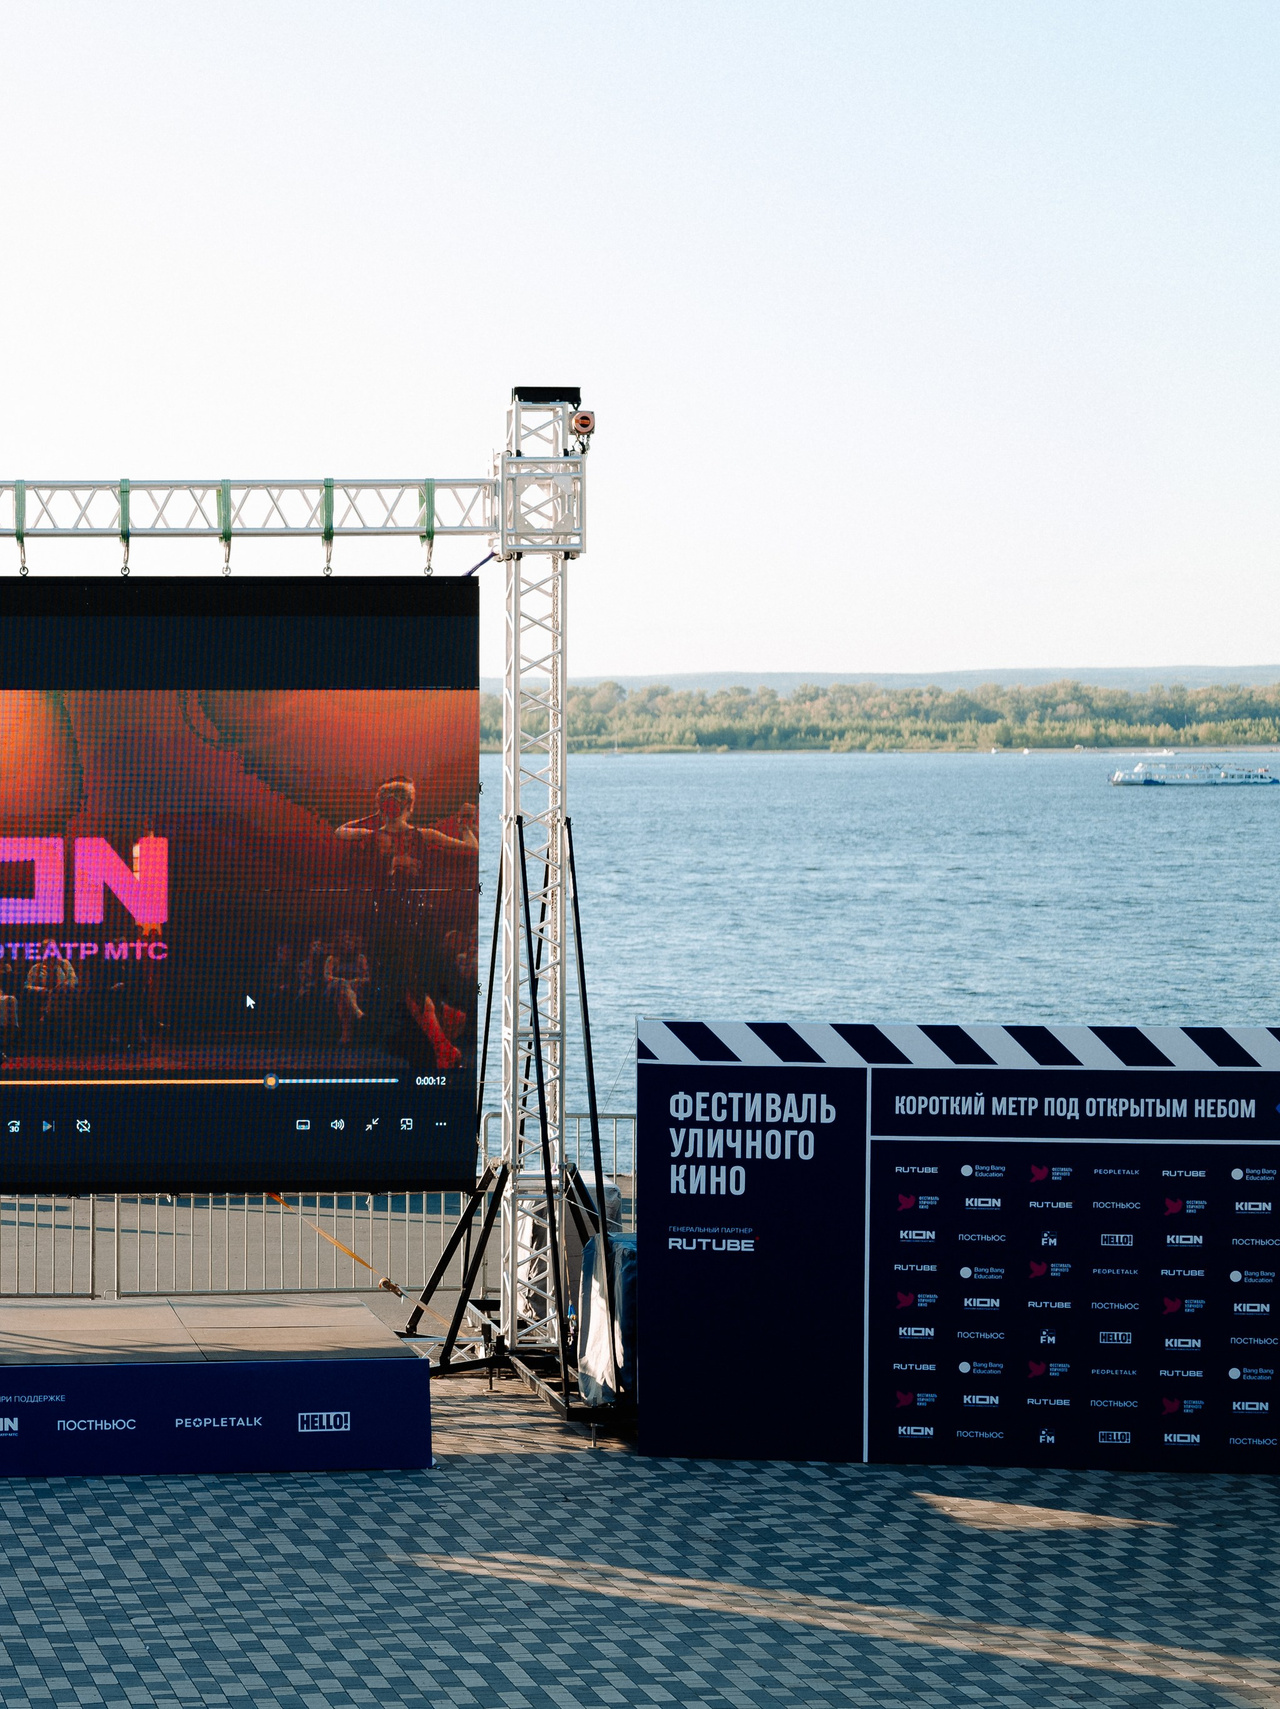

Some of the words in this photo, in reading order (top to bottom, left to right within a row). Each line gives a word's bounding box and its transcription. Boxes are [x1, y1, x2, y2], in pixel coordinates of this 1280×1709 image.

[103, 941, 169, 960] МТС
[415, 1076, 447, 1087] 0:00:12
[669, 1091, 837, 1124] ФЕСТИВАЛЬ
[894, 1091, 985, 1116] КОРОТКИЙ
[991, 1097, 1039, 1117] МЕТР
[1043, 1098, 1080, 1120] ПОД
[1085, 1098, 1188, 1118] ОТКРЫТЫМ
[1194, 1098, 1256, 1119] НЕБОМ
[668, 1127, 815, 1161] УЛИЧНОГО
[895, 1166, 939, 1174] RUTUBE
[1161, 1169, 1207, 1178] RUTUBE
[669, 1163, 746, 1196] КИНО
[965, 1198, 1002, 1207] KION
[1029, 1201, 1073, 1209] RUTUBE
[1092, 1201, 1141, 1210] ПОСТНЬЮС
[1235, 1202, 1272, 1211] KION
[668, 1225, 720, 1234] ГЕНЕРАЛЬНЫЙ
[899, 1230, 936, 1239] KION
[958, 1233, 1007, 1242] ПОСТНЬЮС
[1101, 1234, 1133, 1246] HELLO!
[1166, 1235, 1203, 1244] KION
[1231, 1238, 1280, 1246] ПОСТНЬЮС
[668, 1237, 755, 1252] RUTUBE
[893, 1263, 938, 1272] RUTUBE
[1160, 1269, 1205, 1277] RUTUBE
[963, 1298, 1000, 1307] KION
[1027, 1300, 1072, 1309] RUTUBE
[1091, 1302, 1140, 1310] ПОСТНЬЮС
[1233, 1303, 1271, 1312] KION
[898, 1327, 935, 1336] KION
[957, 1331, 1005, 1340] ПОСТНЬЮС
[1100, 1332, 1131, 1344] HELLO!
[1230, 1337, 1279, 1345] ПОСТНЬЮС
[1164, 1339, 1202, 1347] KION
[893, 1363, 937, 1371] RUTUBE
[1091, 1368, 1137, 1376] PEOPLETALK
[1159, 1369, 1204, 1378] RUTUBE
[14, 1394, 66, 1404] ПОДДЕРЖКЕ
[963, 1395, 1000, 1404] KION
[1026, 1398, 1071, 1406] RUTUBE
[1090, 1399, 1139, 1408] ПОСТНЬЮС
[1232, 1402, 1269, 1410] KION
[57, 1418, 137, 1431] ПОСТНЬЮС
[175, 1416, 263, 1428] PEOPLETALK
[299, 1412, 350, 1432] HELLO!
[897, 1426, 934, 1435] KION
[956, 1430, 1004, 1439] ПОСТНЬЮС
[1099, 1431, 1130, 1443] HELLO!
[1163, 1434, 1201, 1442] KION
[1229, 1437, 1278, 1446] ПОСТНЬЮС
